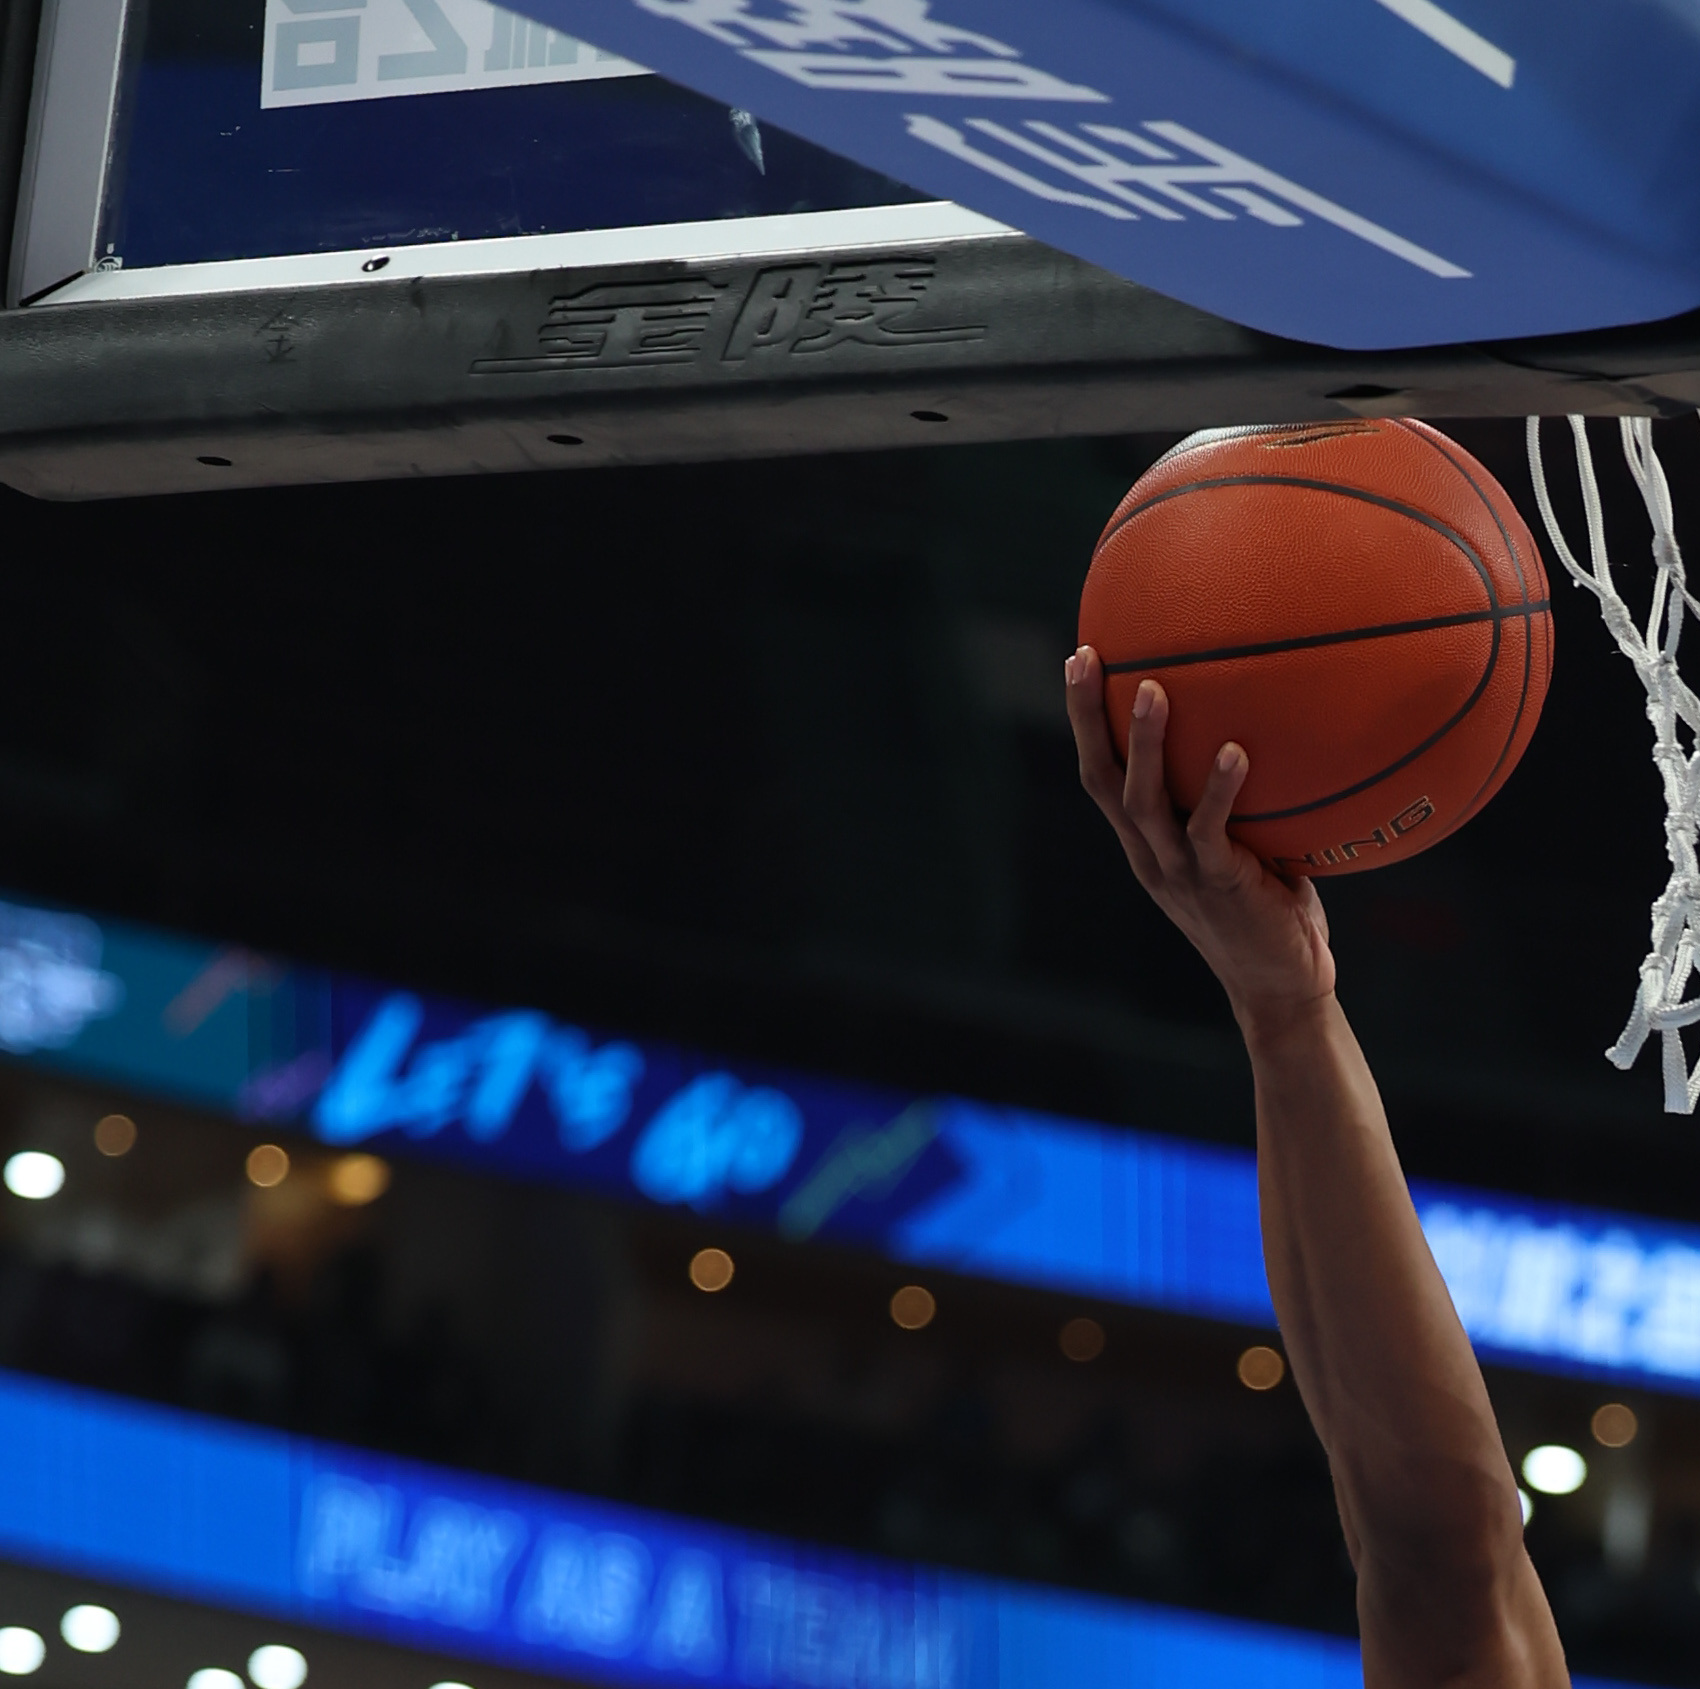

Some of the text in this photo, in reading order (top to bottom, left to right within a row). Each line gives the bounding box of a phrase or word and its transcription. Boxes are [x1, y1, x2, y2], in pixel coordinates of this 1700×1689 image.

[469, 254, 986, 374] 金陵
[305, 1476, 518, 1628] PLAY
[514, 1520, 656, 1660] AS
[652, 1545, 728, 1678] A
